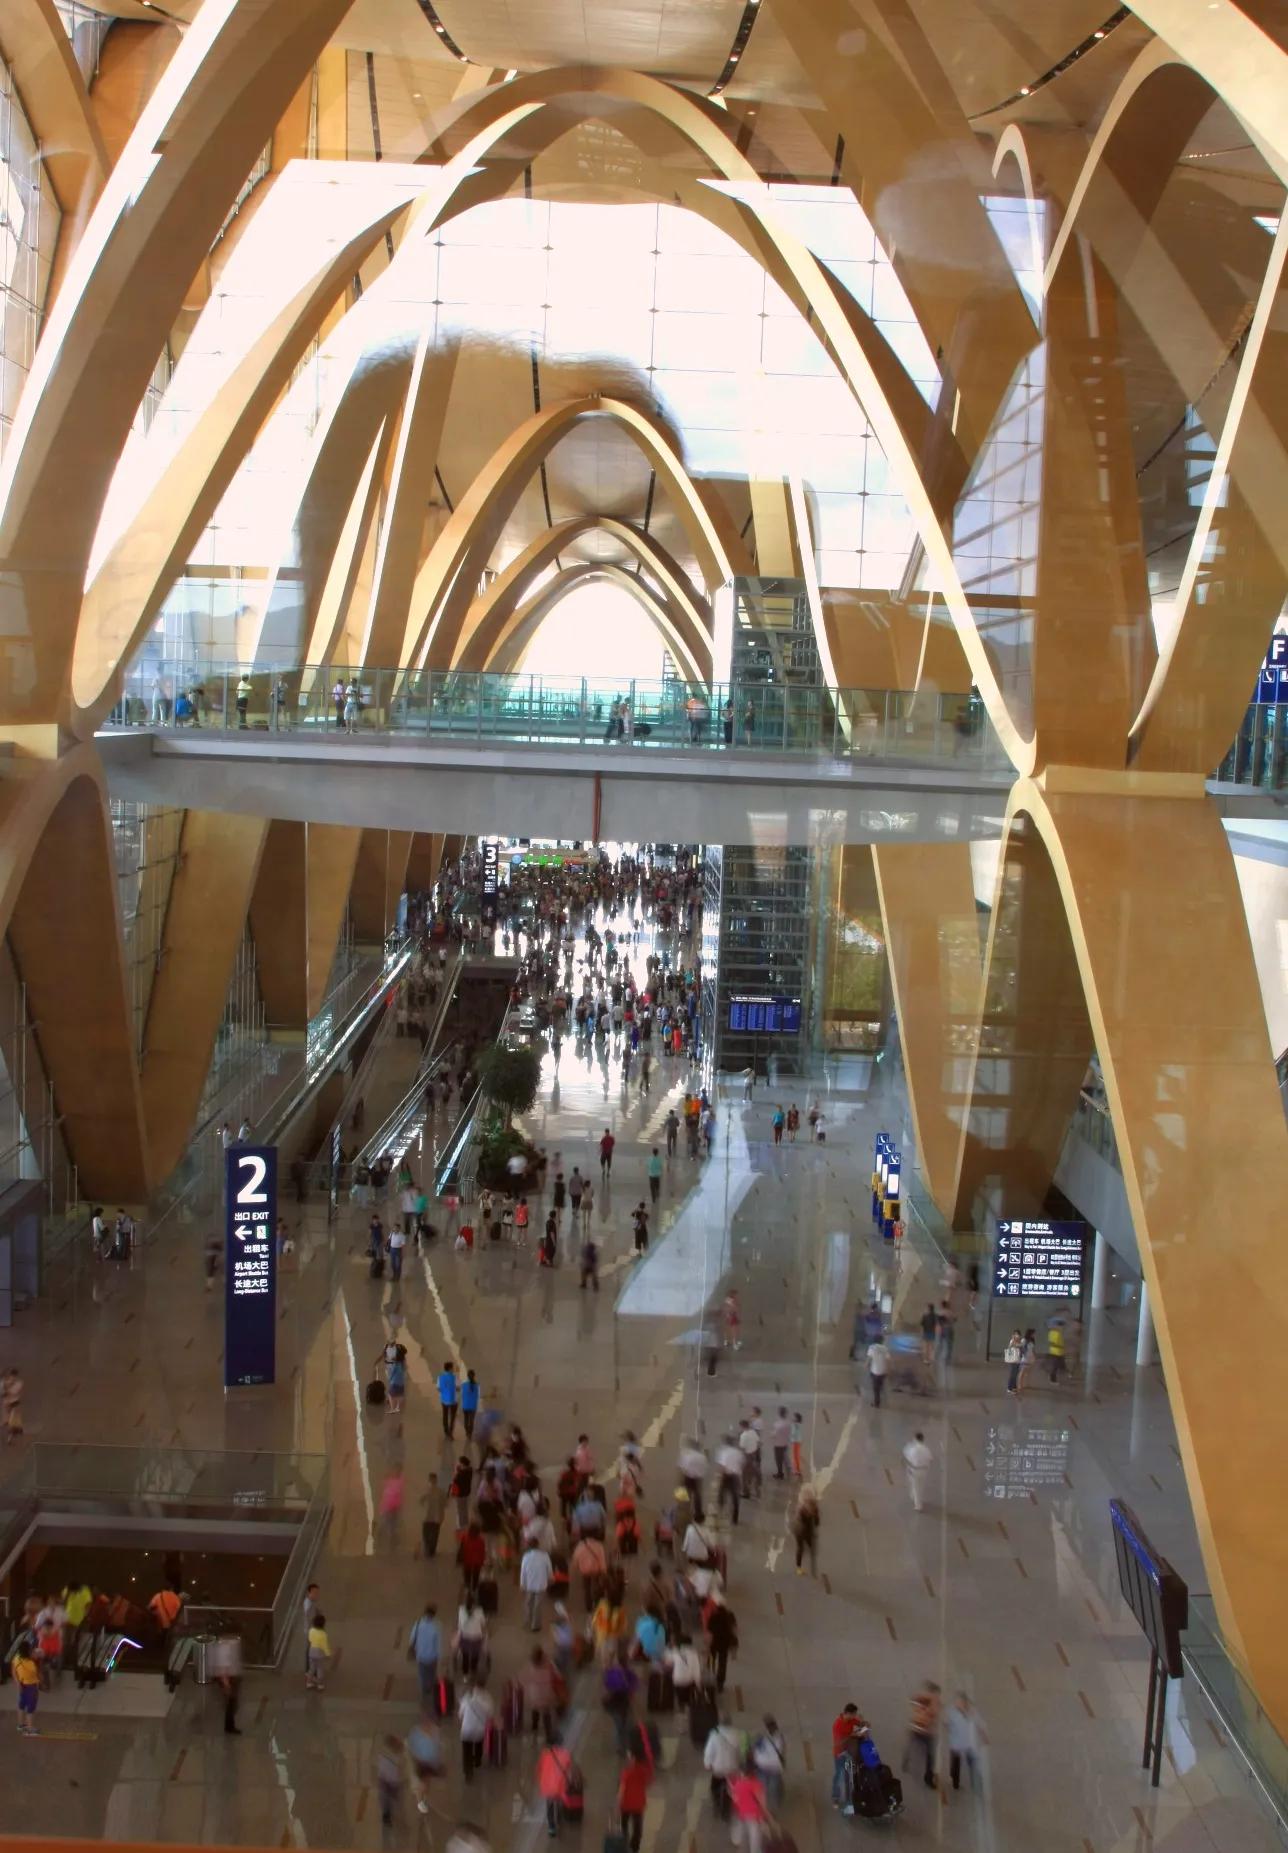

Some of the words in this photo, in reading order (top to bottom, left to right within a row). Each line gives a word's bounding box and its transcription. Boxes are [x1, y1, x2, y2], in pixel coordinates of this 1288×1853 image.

[1272, 639, 1286, 660] F
[485, 846, 497, 863] 3
[237, 1155, 267, 1203] 2
[235, 1212, 250, 1220] 出口
[252, 1212, 269, 1220] EXIT
[244, 1244, 269, 1253] 出租车
[234, 1261, 269, 1271] 机场大巴
[234, 1279, 268, 1288] 长途大巴
